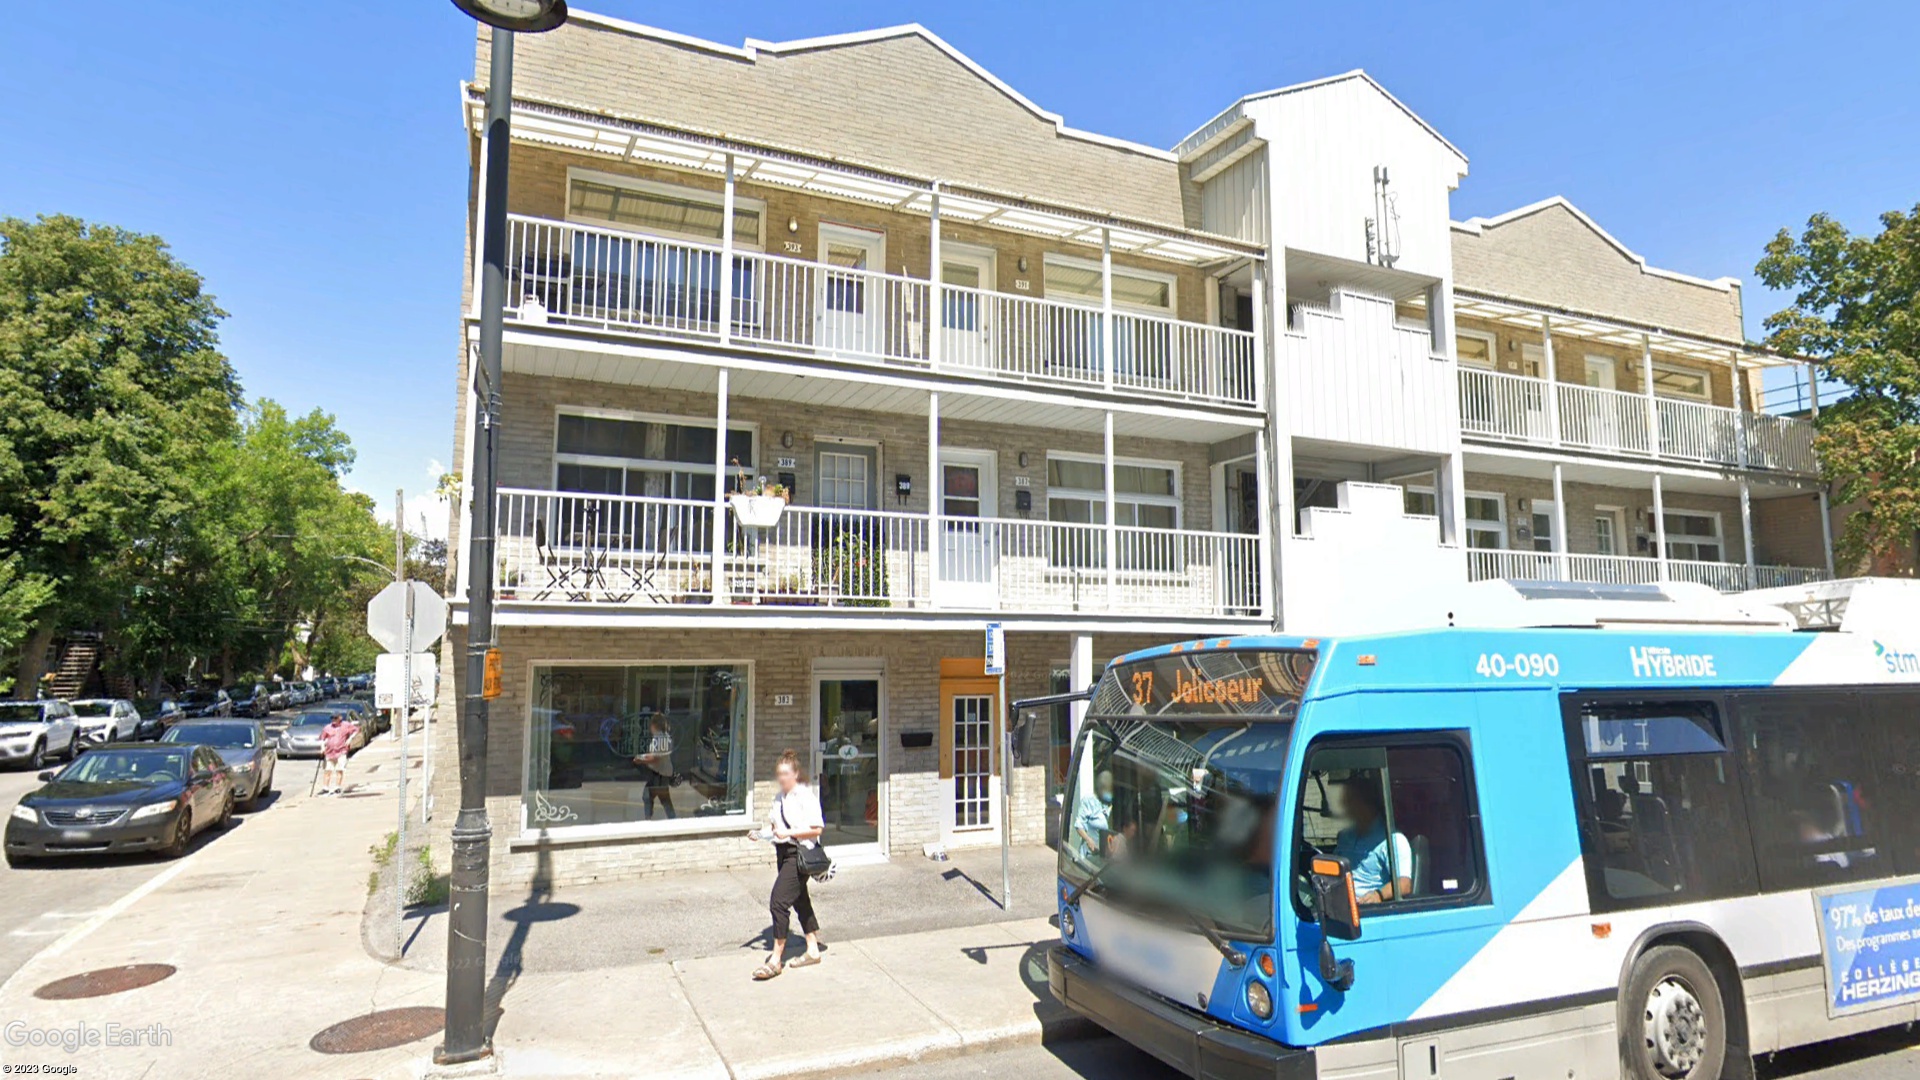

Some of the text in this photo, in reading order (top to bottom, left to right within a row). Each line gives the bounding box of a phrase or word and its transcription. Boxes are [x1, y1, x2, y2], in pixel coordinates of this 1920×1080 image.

[1476, 653, 1559, 678] 40-090
[1630, 646, 1717, 678] HYBRIDE
[1885, 649, 1920, 673] stm
[1132, 668, 1262, 704] 37 Jolicoeur
[1830, 904, 1862, 931] 97%
[1863, 903, 1879, 925] de
[1878, 907, 1905, 923] taux
[1836, 935, 1856, 952] Des
[1856, 930, 1911, 954] programmes
[1842, 971, 1920, 1002] HERZING
